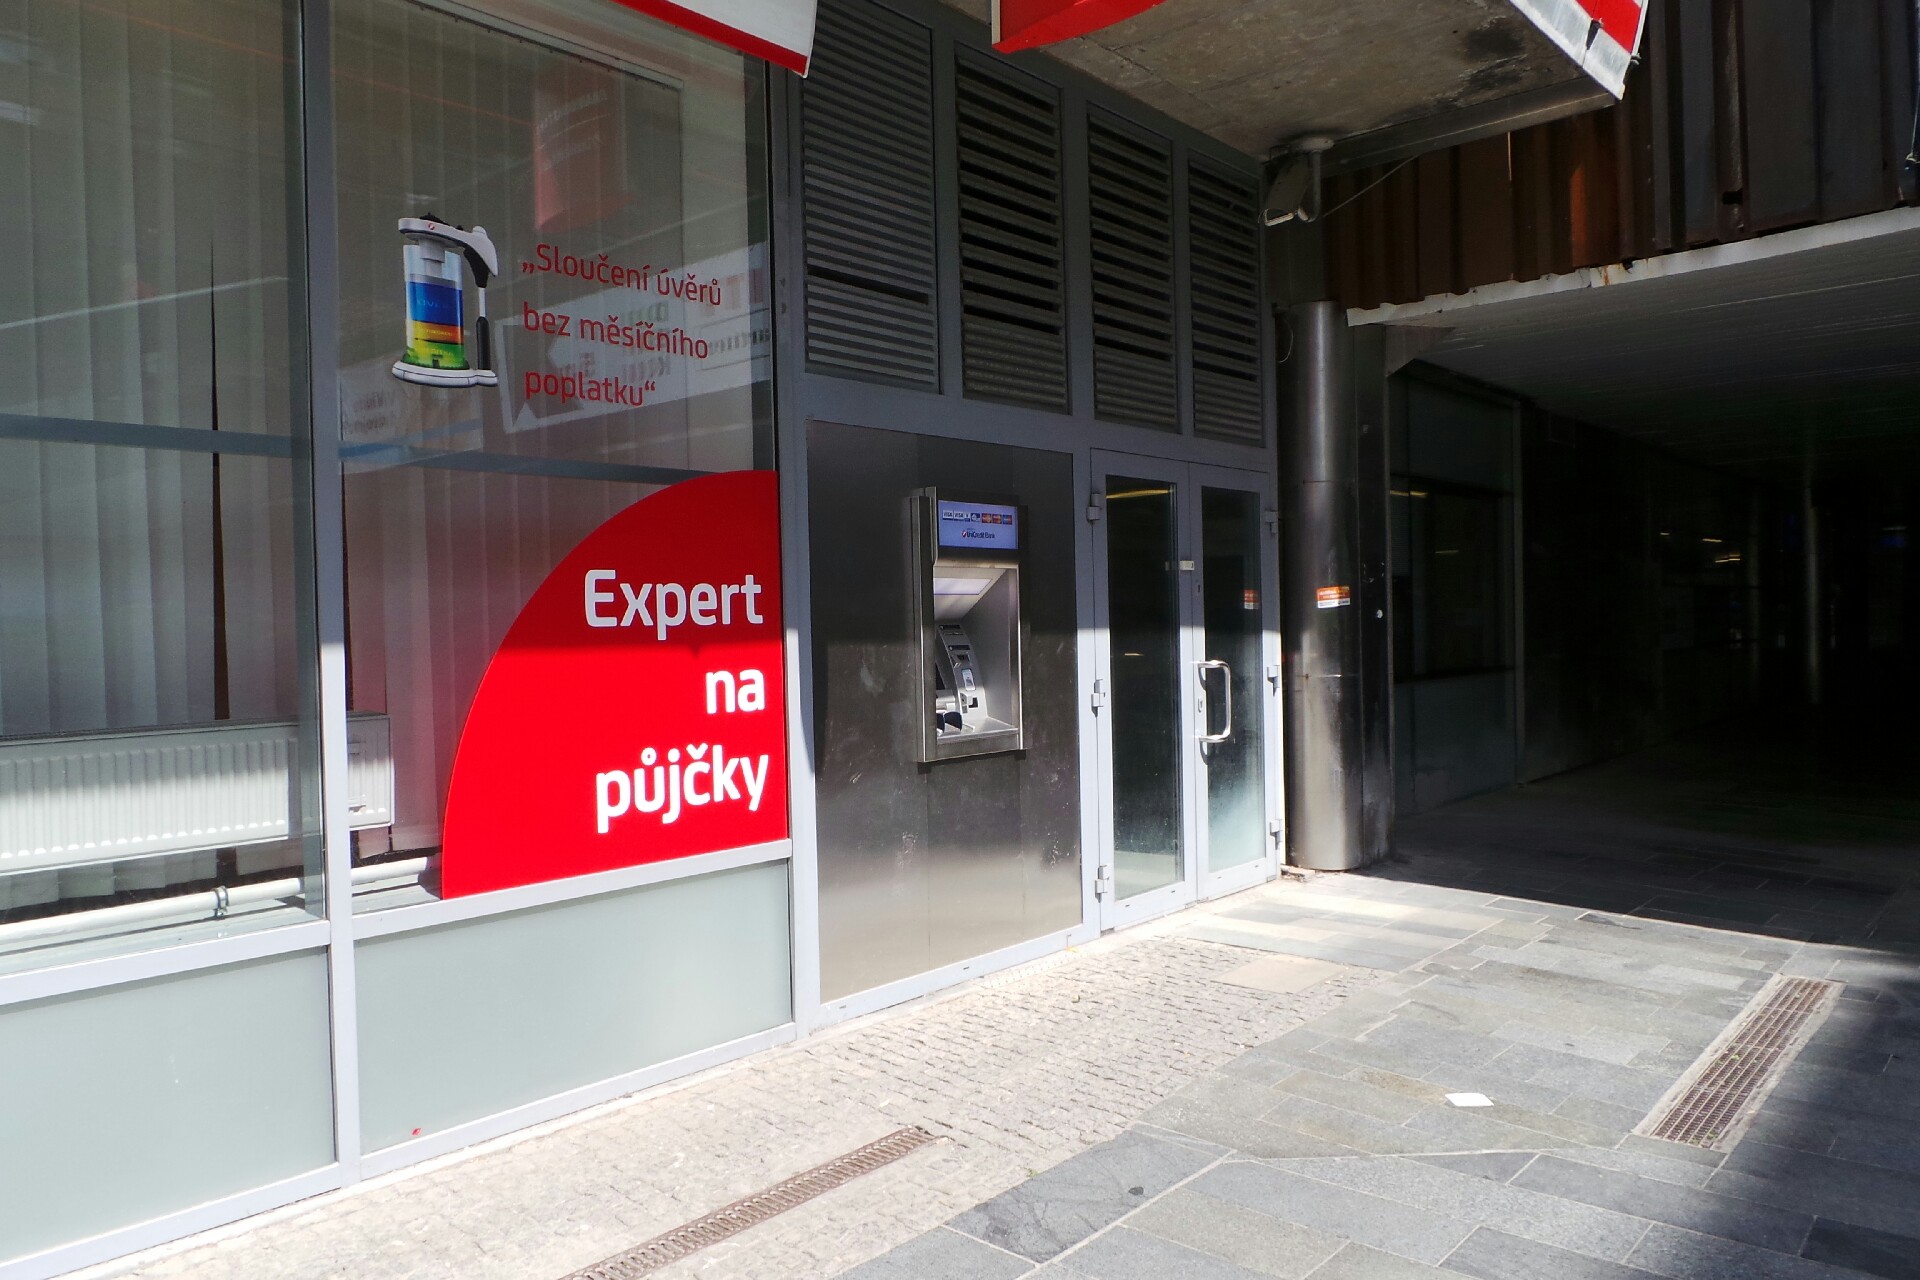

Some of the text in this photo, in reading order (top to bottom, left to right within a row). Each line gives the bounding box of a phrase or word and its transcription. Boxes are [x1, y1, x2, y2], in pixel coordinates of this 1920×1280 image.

[522, 243, 649, 291] „Sloučení
[657, 268, 721, 306] úvěrů
[523, 301, 571, 337] bez
[580, 314, 708, 359] měsíčního
[525, 371, 656, 407] poplatku“
[966, 530, 995, 539] UniCredit Bank
[584, 569, 764, 641] Expert
[705, 668, 766, 715] na
[595, 742, 769, 834] půjčky
